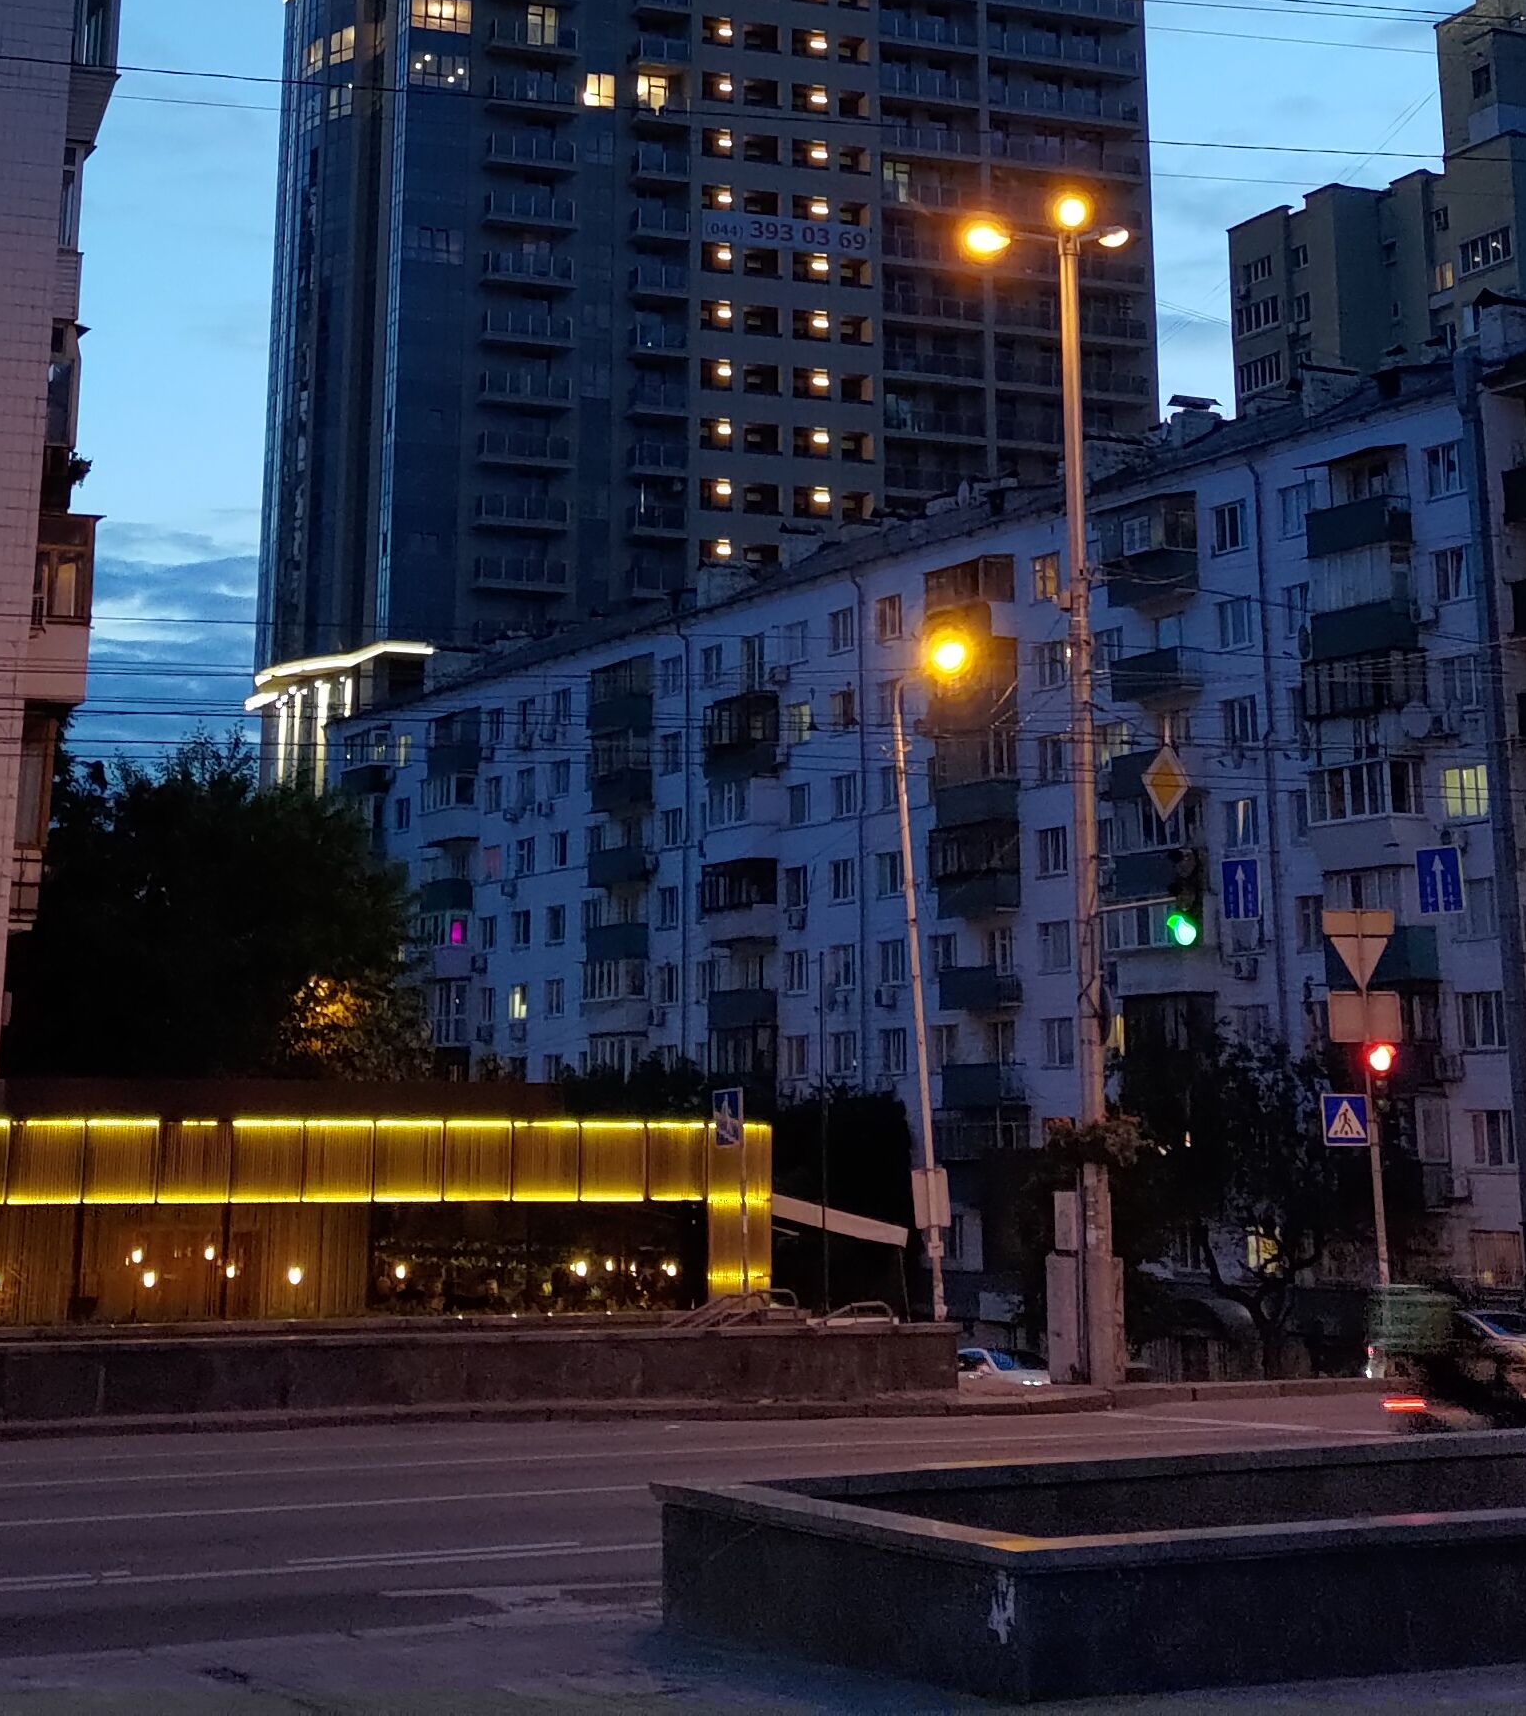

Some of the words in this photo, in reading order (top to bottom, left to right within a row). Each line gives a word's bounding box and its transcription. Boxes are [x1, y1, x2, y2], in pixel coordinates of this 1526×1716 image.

[705, 223, 743, 240] (044)
[750, 220, 794, 242] 393
[802, 225, 830, 246] 03
[838, 230, 866, 251] 69
